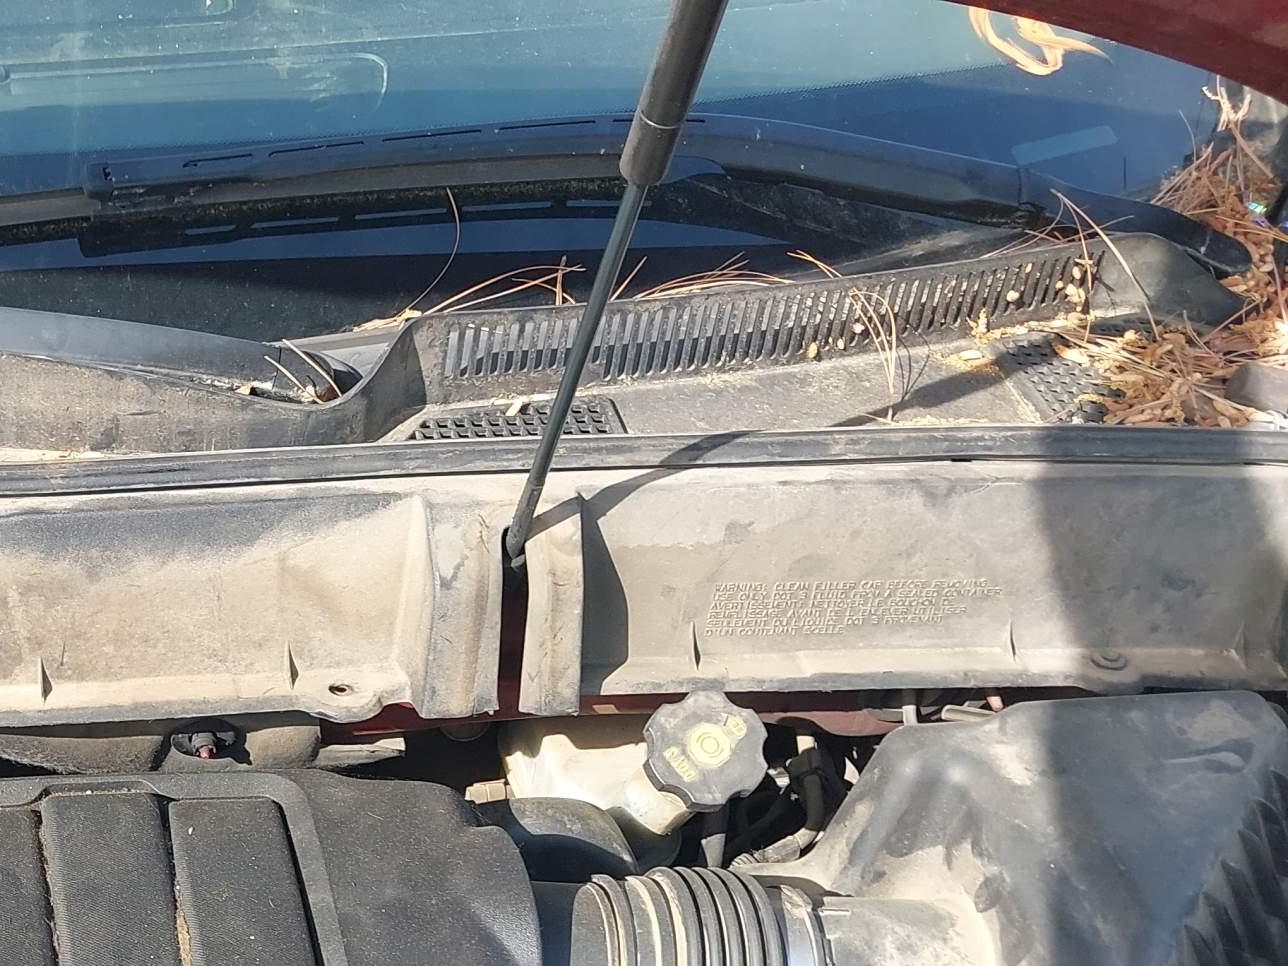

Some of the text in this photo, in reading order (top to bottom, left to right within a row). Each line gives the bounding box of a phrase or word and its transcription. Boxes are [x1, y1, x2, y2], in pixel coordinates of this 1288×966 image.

[774, 581, 809, 591] CLEAN
[813, 580, 856, 591] FILLER
[712, 591, 734, 601] USE
[738, 590, 768, 601] ONLY
[773, 590, 795, 601] DOT
[811, 589, 847, 600] FLUID
[897, 587, 938, 598] SEALED
